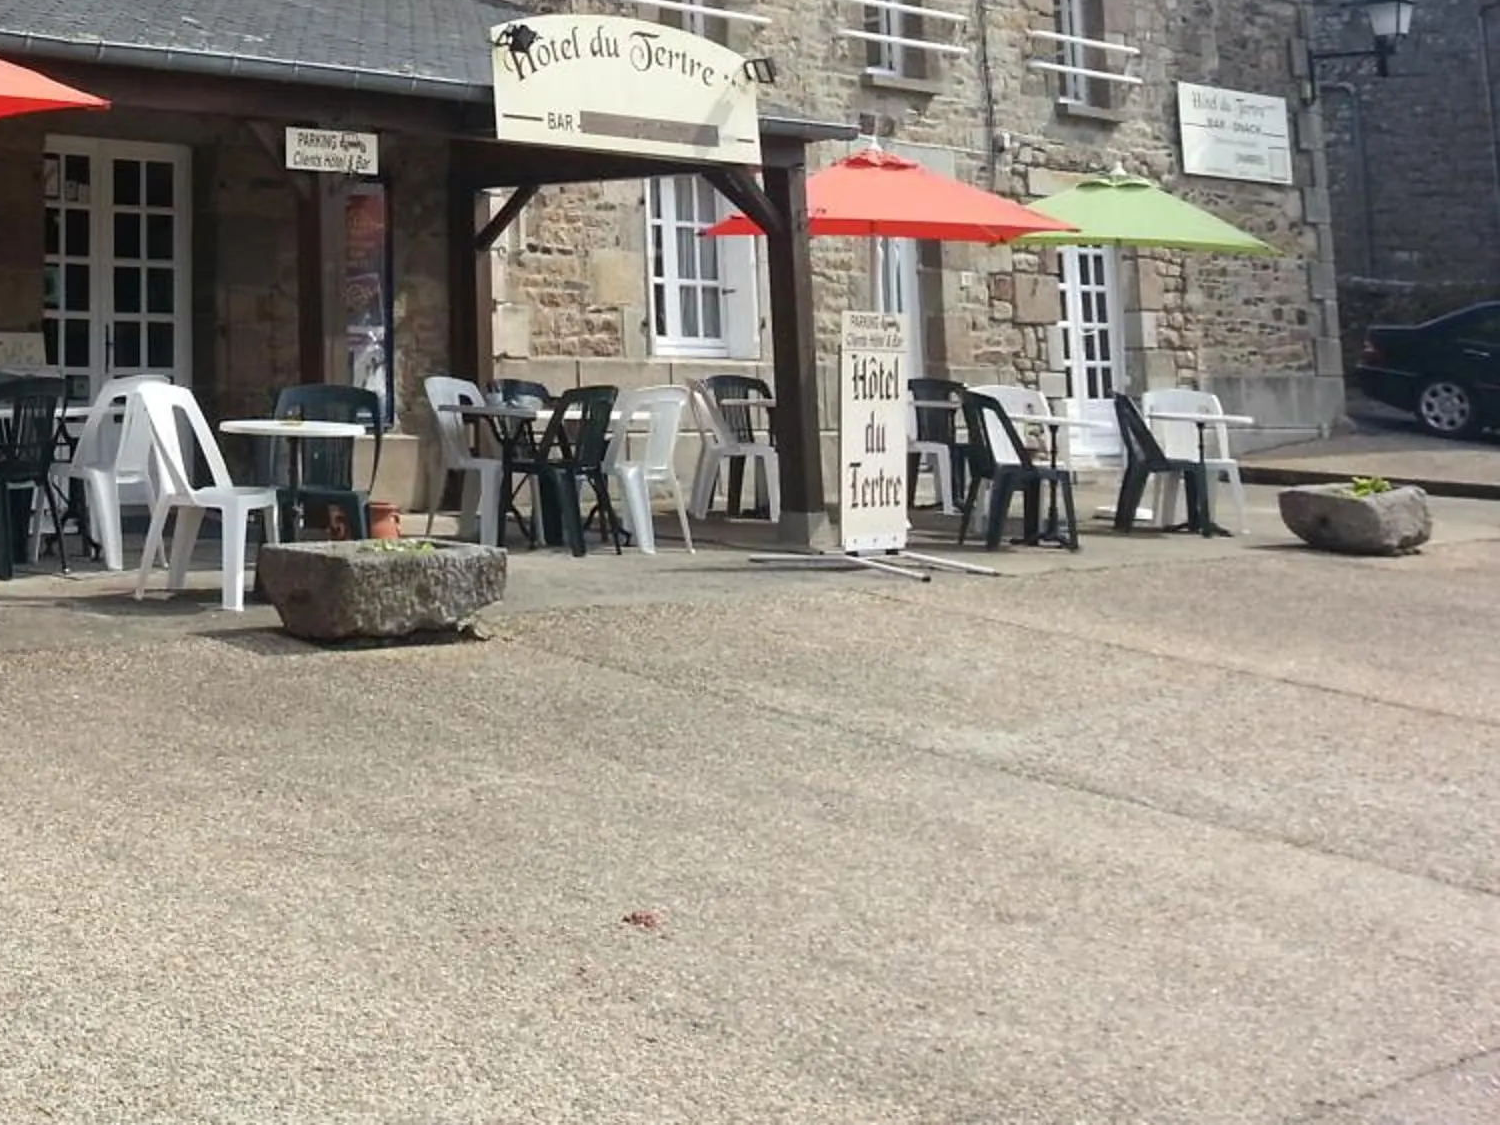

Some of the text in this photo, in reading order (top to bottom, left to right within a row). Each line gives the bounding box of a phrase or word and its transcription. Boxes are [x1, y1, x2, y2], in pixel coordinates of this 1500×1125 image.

[590, 25, 621, 59] du
[630, 30, 715, 87] Tertre
[297, 131, 337, 150] PARKING
[547, 112, 574, 131] BAR
[850, 354, 900, 401] Hôtel
[865, 411, 886, 454] du
[849, 462, 902, 508] Tertre
